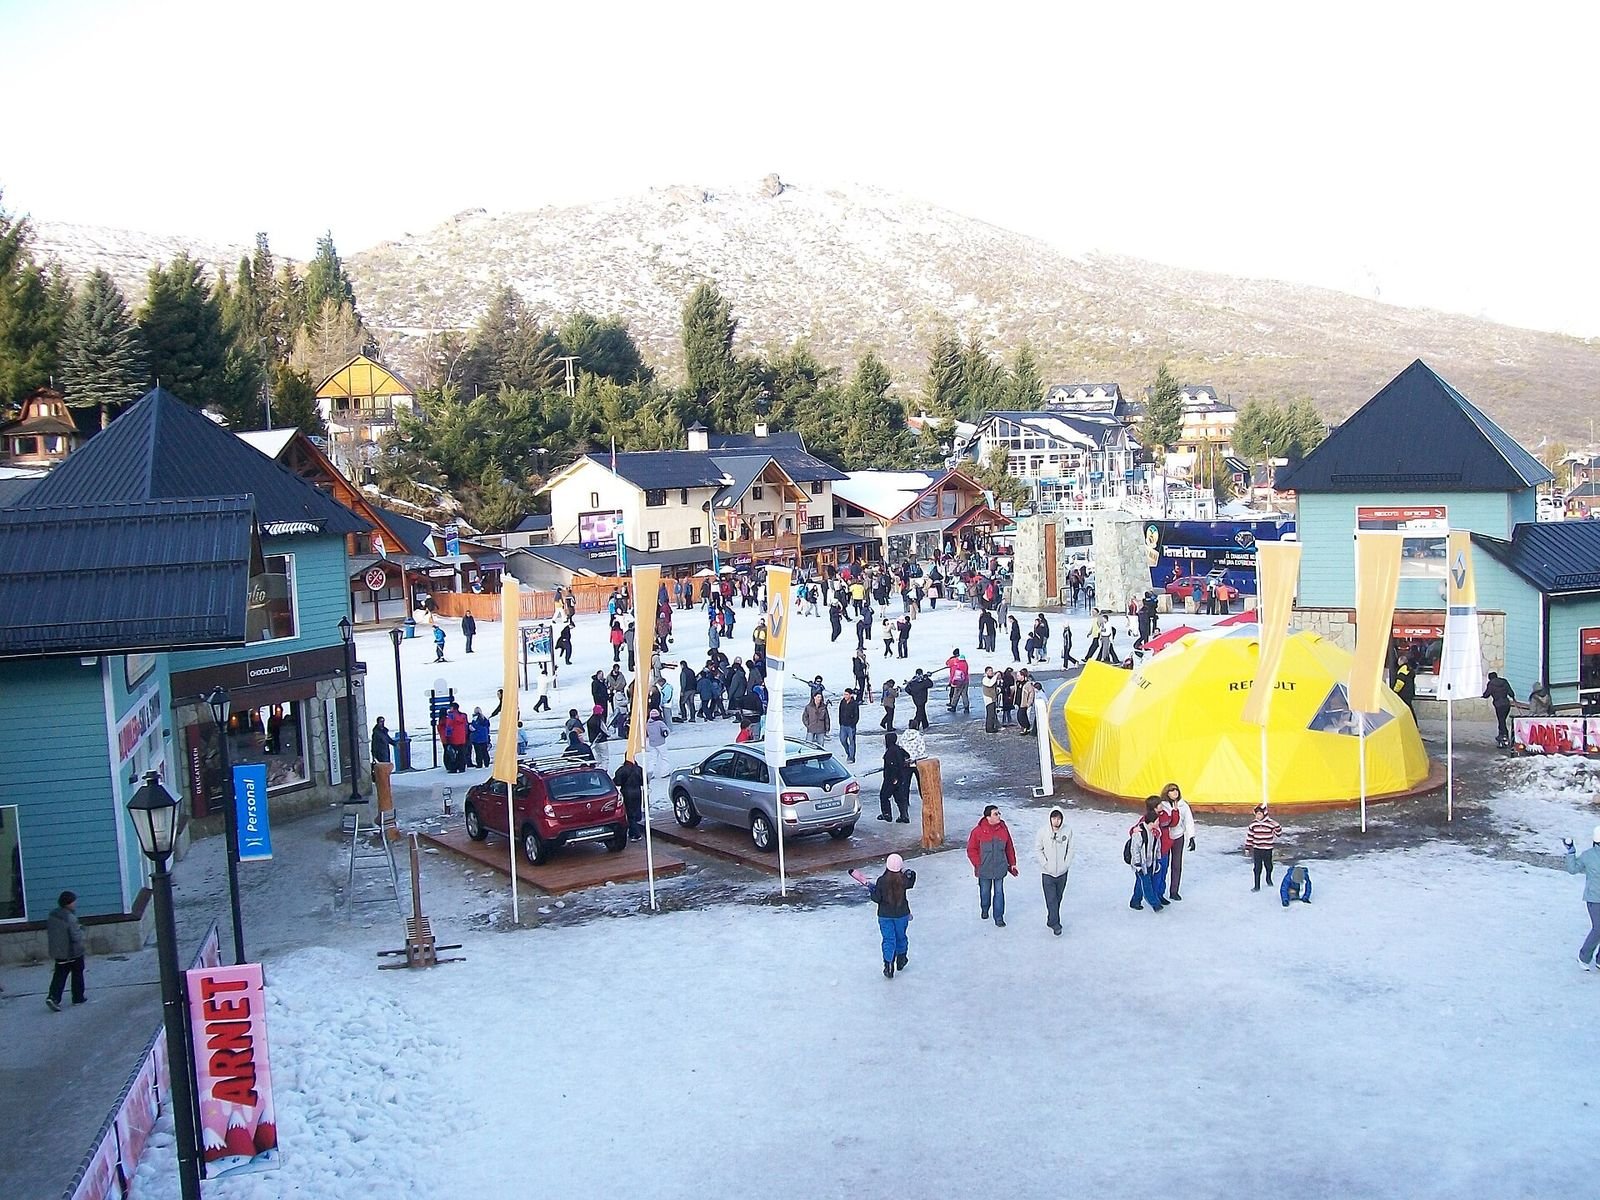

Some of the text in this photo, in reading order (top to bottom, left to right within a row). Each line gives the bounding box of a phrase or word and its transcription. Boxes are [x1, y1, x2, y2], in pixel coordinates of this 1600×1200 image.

[1163, 546, 1207, 559] Fernet Branca
[193, 747, 201, 794] DELICATESSEN
[243, 779, 258, 832] Personal
[201, 976, 258, 1108] ARNET
